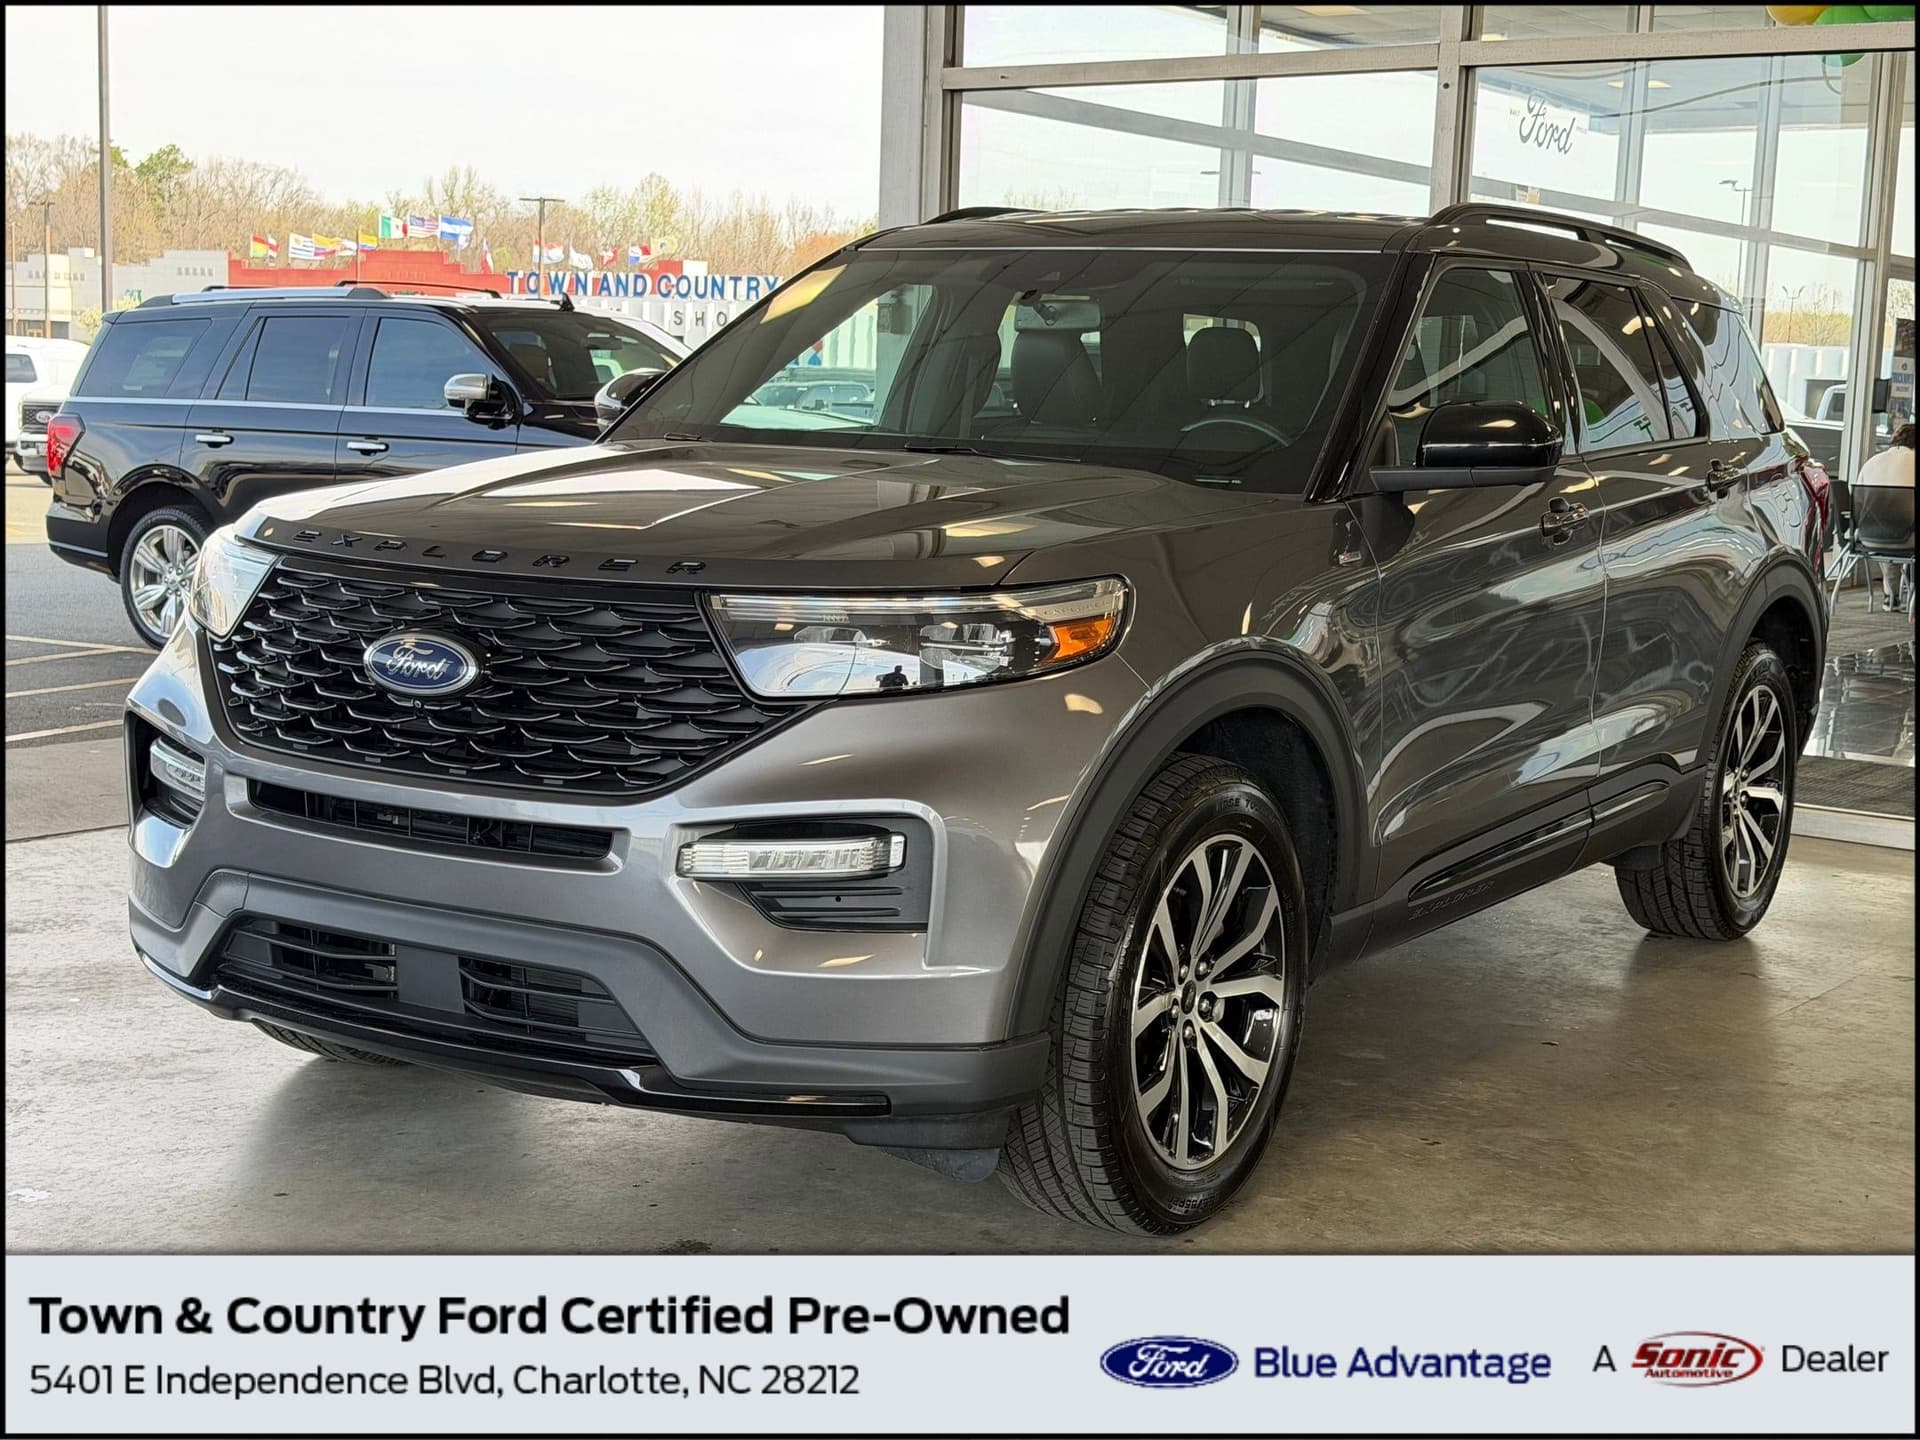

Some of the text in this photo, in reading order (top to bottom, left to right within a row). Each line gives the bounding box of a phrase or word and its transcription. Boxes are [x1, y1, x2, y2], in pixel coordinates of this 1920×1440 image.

[1519, 92, 1576, 155] Ford
[507, 271, 778, 301] TOWN AND COUNTRY
[293, 529, 707, 575] EXPLORER
[386, 645, 445, 681] Ford
